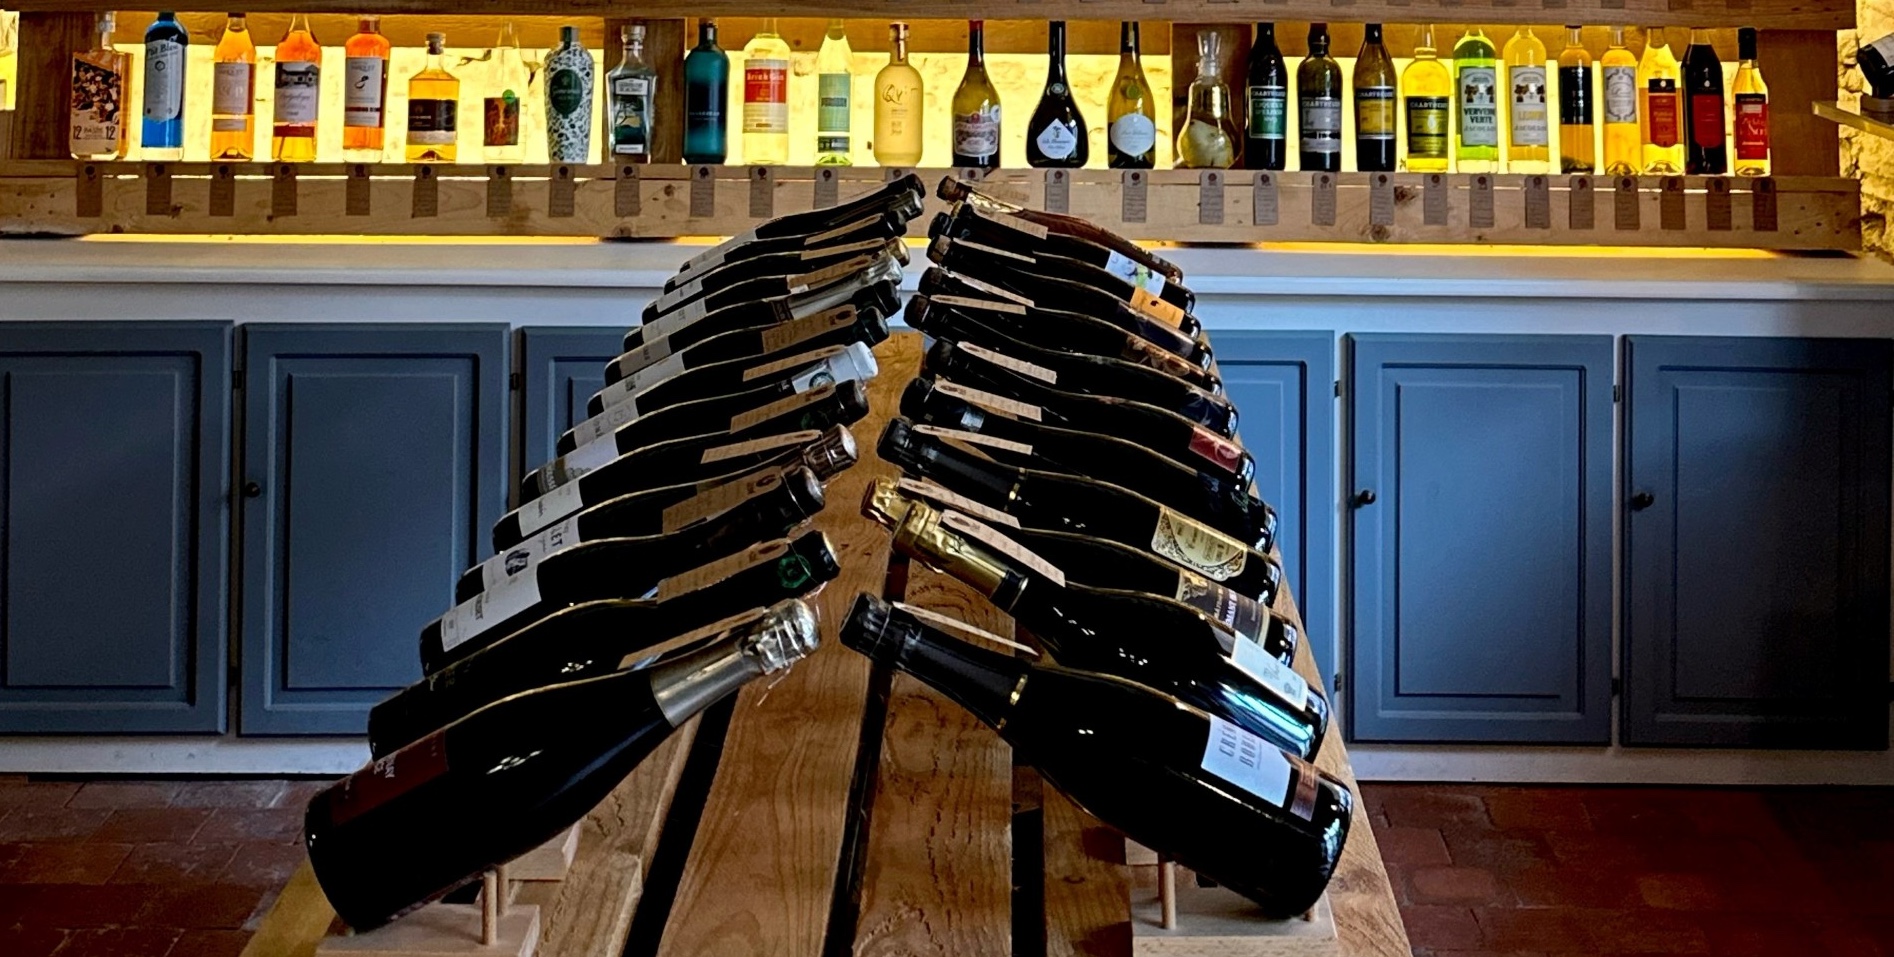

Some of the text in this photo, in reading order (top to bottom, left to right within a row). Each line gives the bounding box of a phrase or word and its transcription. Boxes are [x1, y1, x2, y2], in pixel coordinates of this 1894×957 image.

[1470, 116, 1493, 124] VERTE
[73, 125, 82, 140] 12
[106, 126, 116, 140] 12
